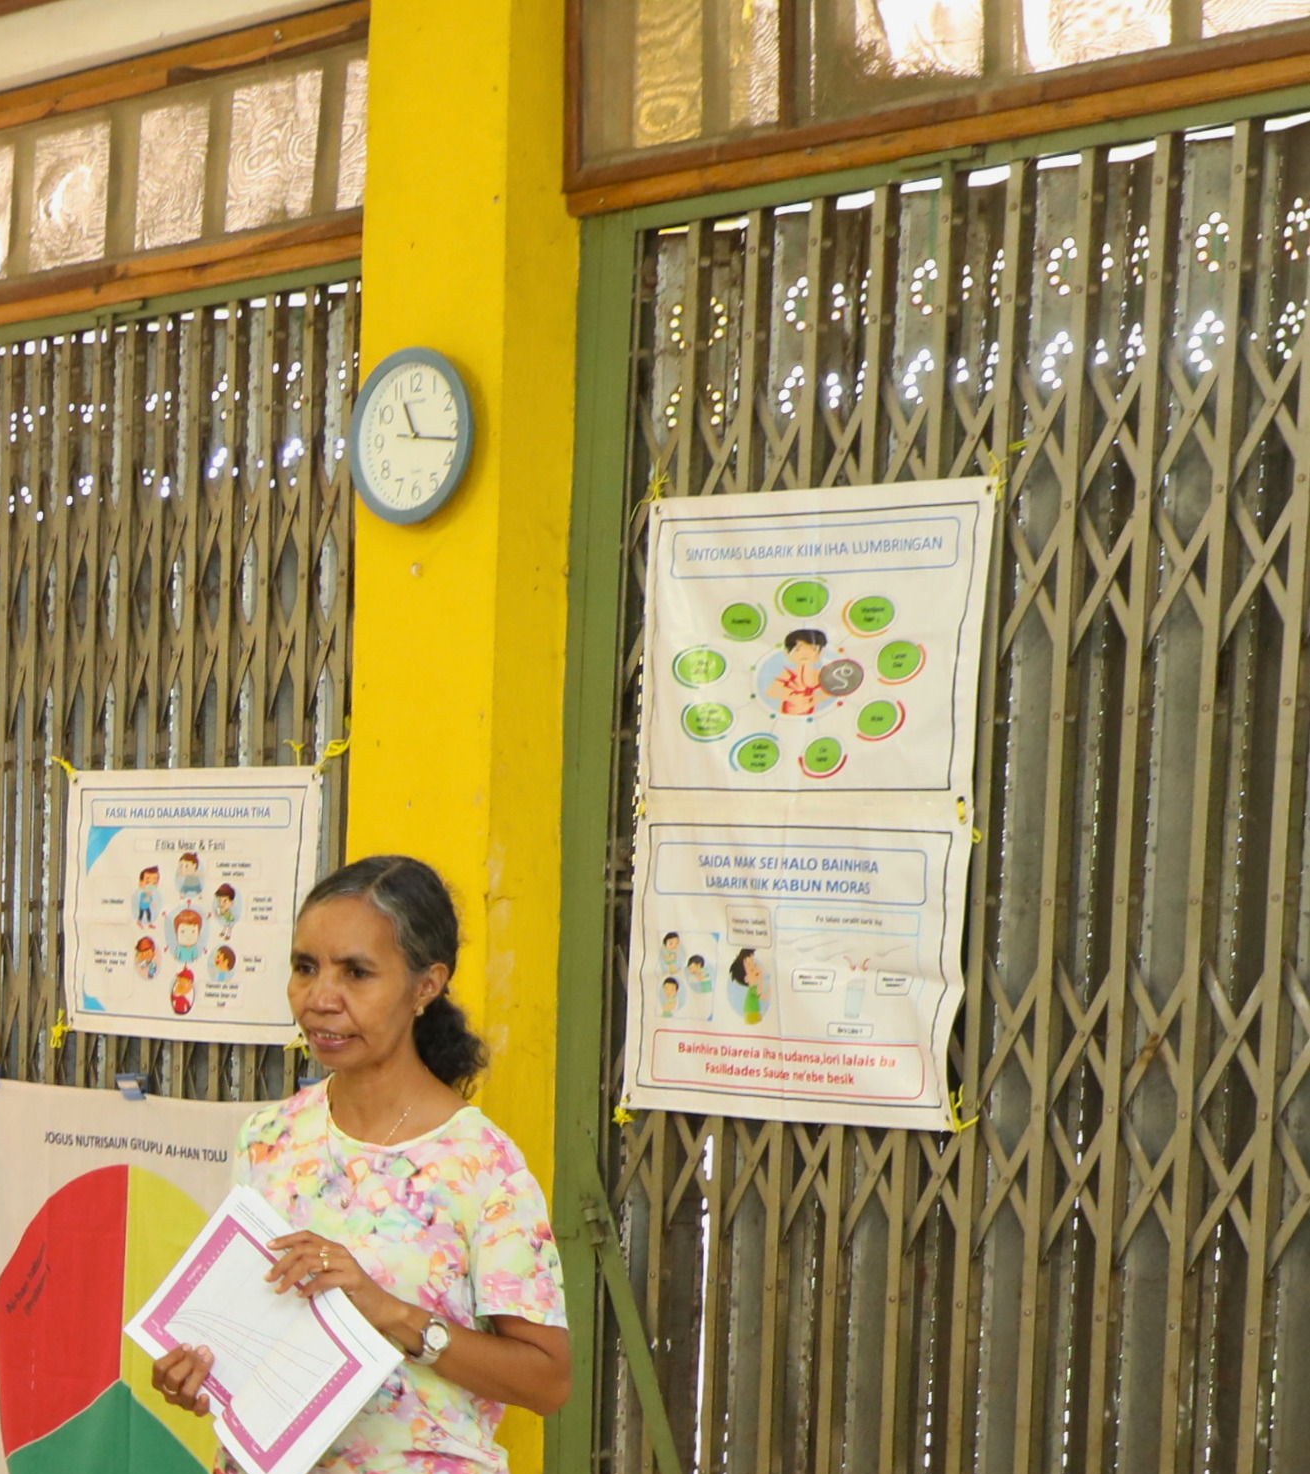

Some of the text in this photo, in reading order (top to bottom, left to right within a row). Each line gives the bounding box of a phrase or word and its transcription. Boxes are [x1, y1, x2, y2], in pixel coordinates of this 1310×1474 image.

[394, 381, 403, 401] 11
[409, 372, 423, 393] 12
[443, 390, 454, 412] 2
[379, 404, 394, 426] 10
[374, 434, 385, 454] 9
[380, 459, 391, 480] 8
[394, 477, 405, 498] 7
[410, 480, 422, 501] 6
[429, 472, 440, 492] 5
[685, 546, 743, 563] SINTOMAS
[744, 544, 795, 560] LABARIK
[824, 540, 849, 556] IHA
[852, 535, 943, 555] LUMBRINGAN
[129, 807, 155, 818] HALO
[251, 806, 271, 818] TIHA
[698, 854, 879, 874] SAIDA MAK SEI HALO BAINHIRA
[772, 877, 821, 892] KABUN
[825, 880, 871, 895] MORAS
[678, 1042, 719, 1057] Bainhira
[720, 1045, 760, 1060] Diareia
[842, 1054, 876, 1067] lalais
[878, 1055, 896, 1068] ba
[827, 1071, 855, 1085] besik
[44, 1131, 228, 1162] JOGUS NUTRISAUN GRUPU AI-HAN TOLU
